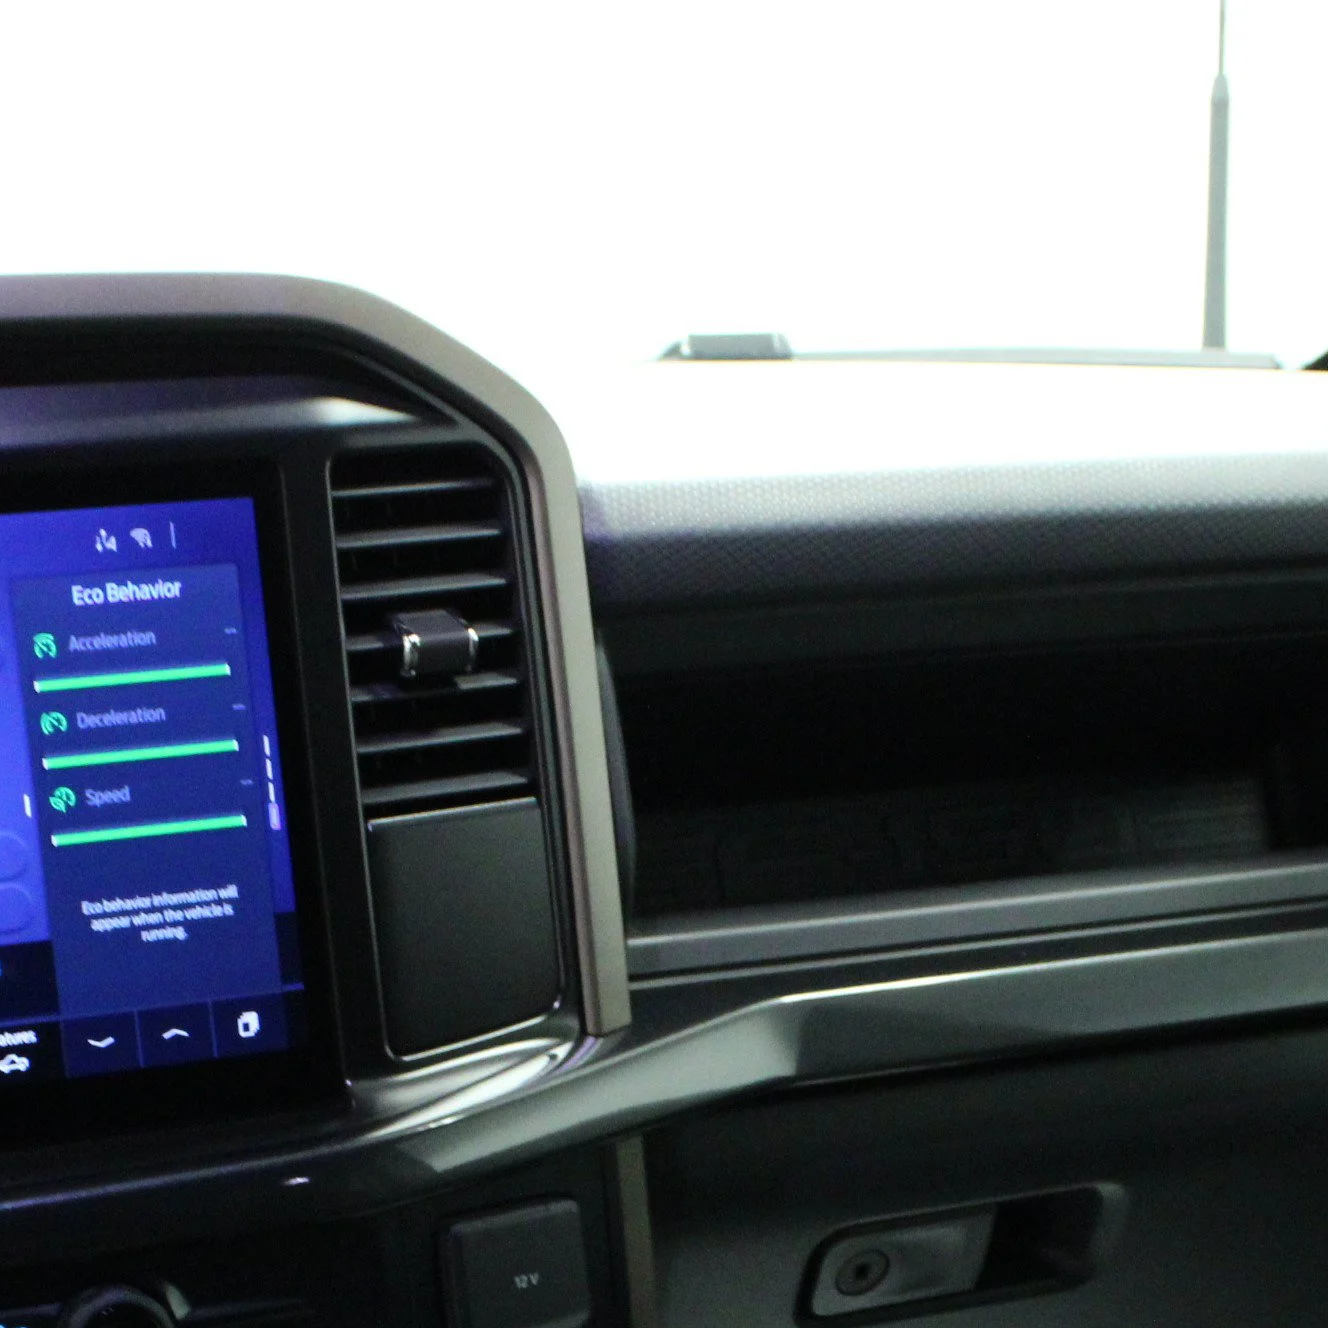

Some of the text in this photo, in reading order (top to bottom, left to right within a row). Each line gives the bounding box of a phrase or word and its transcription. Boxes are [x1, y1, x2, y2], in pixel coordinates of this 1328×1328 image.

[72, 579, 182, 606] Eco Behavior
[69, 630, 156, 653] Acceleration
[76, 707, 166, 730] Deceleration
[85, 785, 131, 808] Speed
